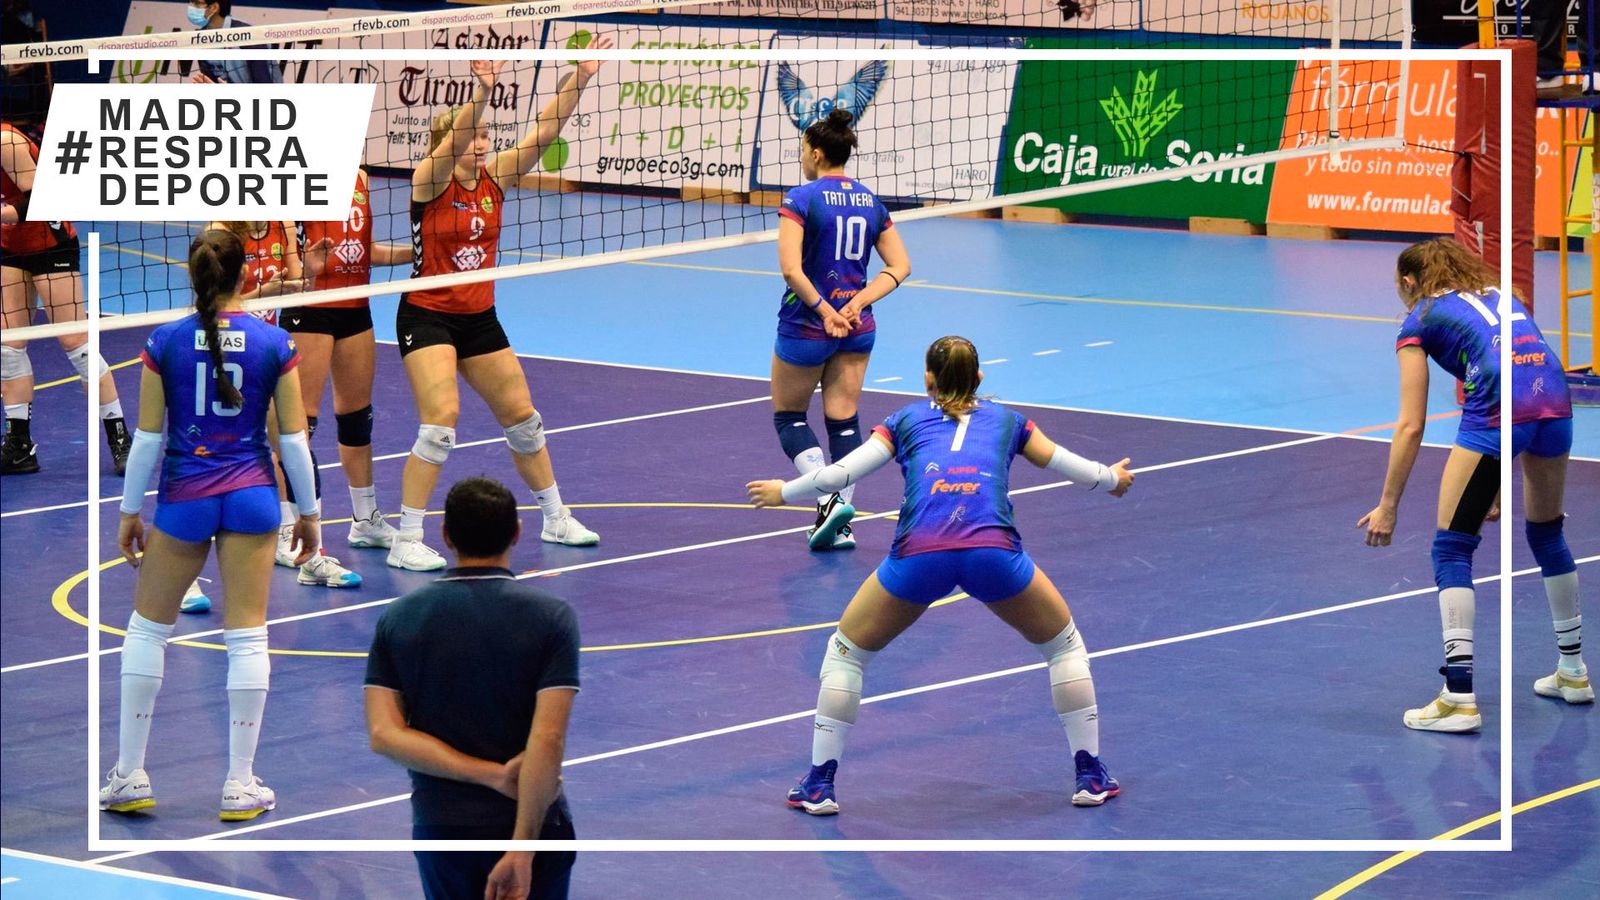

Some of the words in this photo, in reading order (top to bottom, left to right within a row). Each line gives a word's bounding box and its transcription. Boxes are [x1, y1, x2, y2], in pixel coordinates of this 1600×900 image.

[1241, 1, 1330, 22] RIOJANOS
[19, 43, 84, 59] rfevb.com
[190, 31, 252, 46] rfevb.com
[264, 25, 341, 40] disparestudio.com
[352, 17, 411, 32] rfevb.com
[421, 10, 494, 26] disparestudio.com
[506, 4, 561, 18] rfevb.com
[629, 38, 726, 68] GESTIÓN
[728, 44, 761, 69] DE
[398, 65, 520, 111] Tironoa
[619, 82, 751, 111] PROYECTOS
[392, 113, 419, 127] Junto
[667, 126, 685, 150] D
[1416, 134, 1455, 153] host
[596, 155, 745, 180] grupoeco3g.com
[1013, 131, 1099, 186] Caja
[1100, 162, 1136, 179] rural
[1163, 139, 1265, 185] Soria
[1305, 156, 1315, 176] y
[1320, 154, 1356, 174] todo
[1366, 156, 1392, 175] sin
[954, 168, 988, 182] HARO
[822, 190, 847, 206] TATI
[1307, 192, 1452, 216] www.formulac
[470, 216, 486, 241] 9
[835, 215, 868, 261] 10
[195, 361, 244, 417] 13
[942, 414, 972, 452] 7
